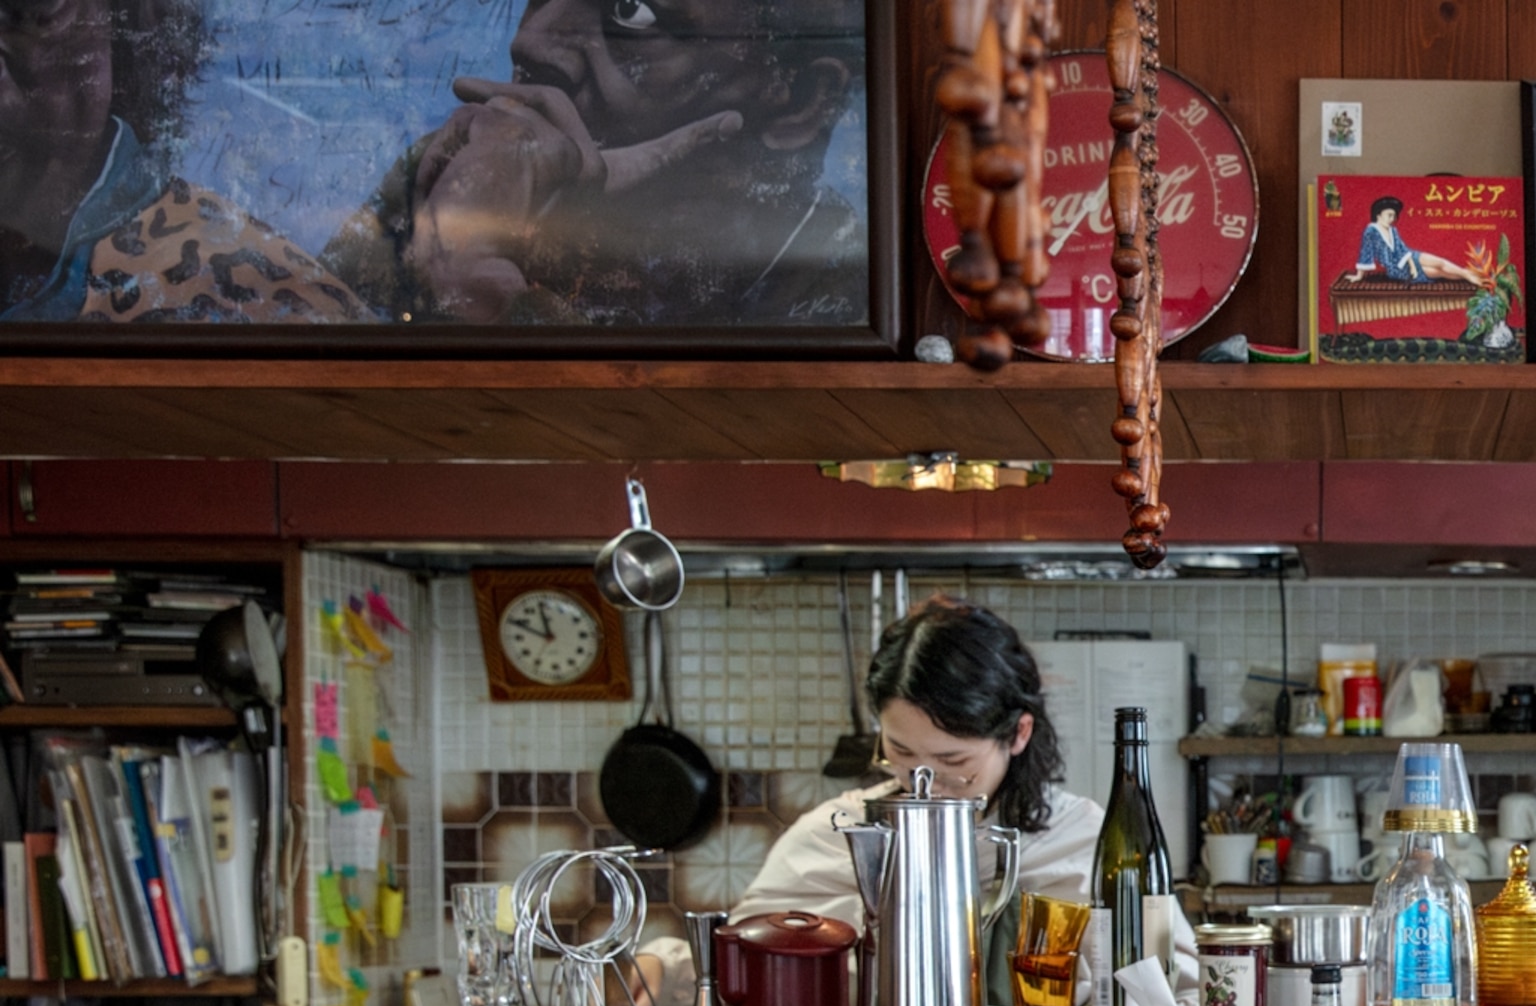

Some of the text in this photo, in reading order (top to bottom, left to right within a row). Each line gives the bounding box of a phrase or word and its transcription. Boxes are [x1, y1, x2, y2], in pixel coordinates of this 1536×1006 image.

[1061, 62, 1082, 85] 10
[1180, 98, 1209, 126] 30
[1214, 153, 1242, 178] 40
[1222, 213, 1248, 239] 50
[1402, 926, 1449, 945] ROJA
